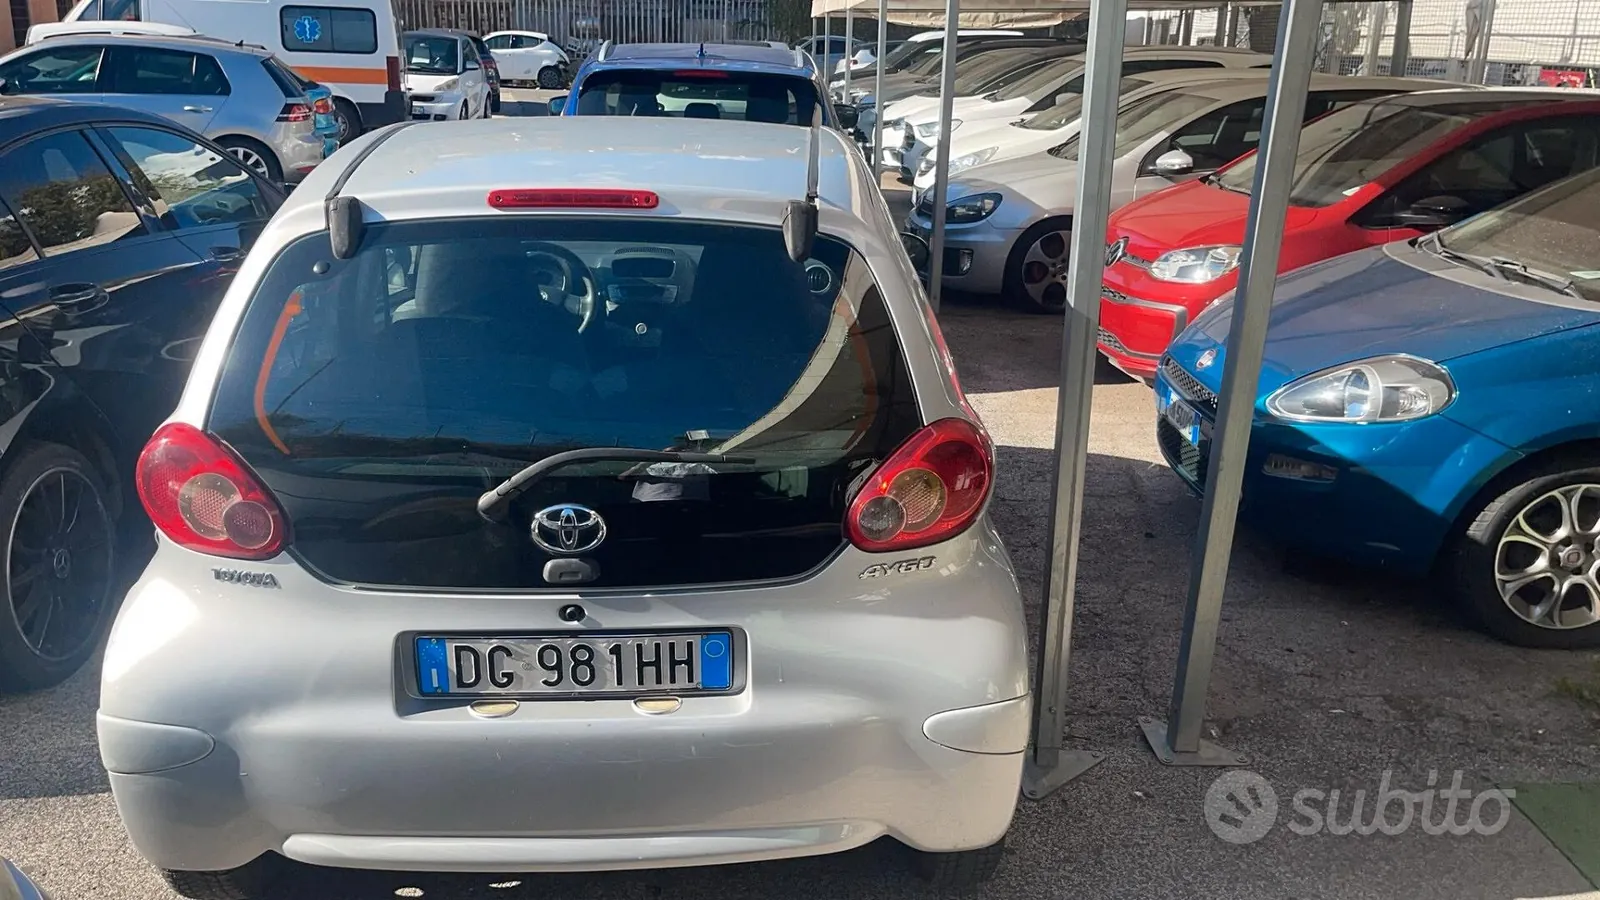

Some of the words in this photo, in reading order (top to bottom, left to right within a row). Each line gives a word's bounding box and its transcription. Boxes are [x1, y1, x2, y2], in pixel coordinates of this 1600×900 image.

[211, 568, 282, 589] TOYOTA
[859, 555, 936, 579] AYGO
[453, 643, 513, 689] DG
[536, 640, 694, 687] 981HH
